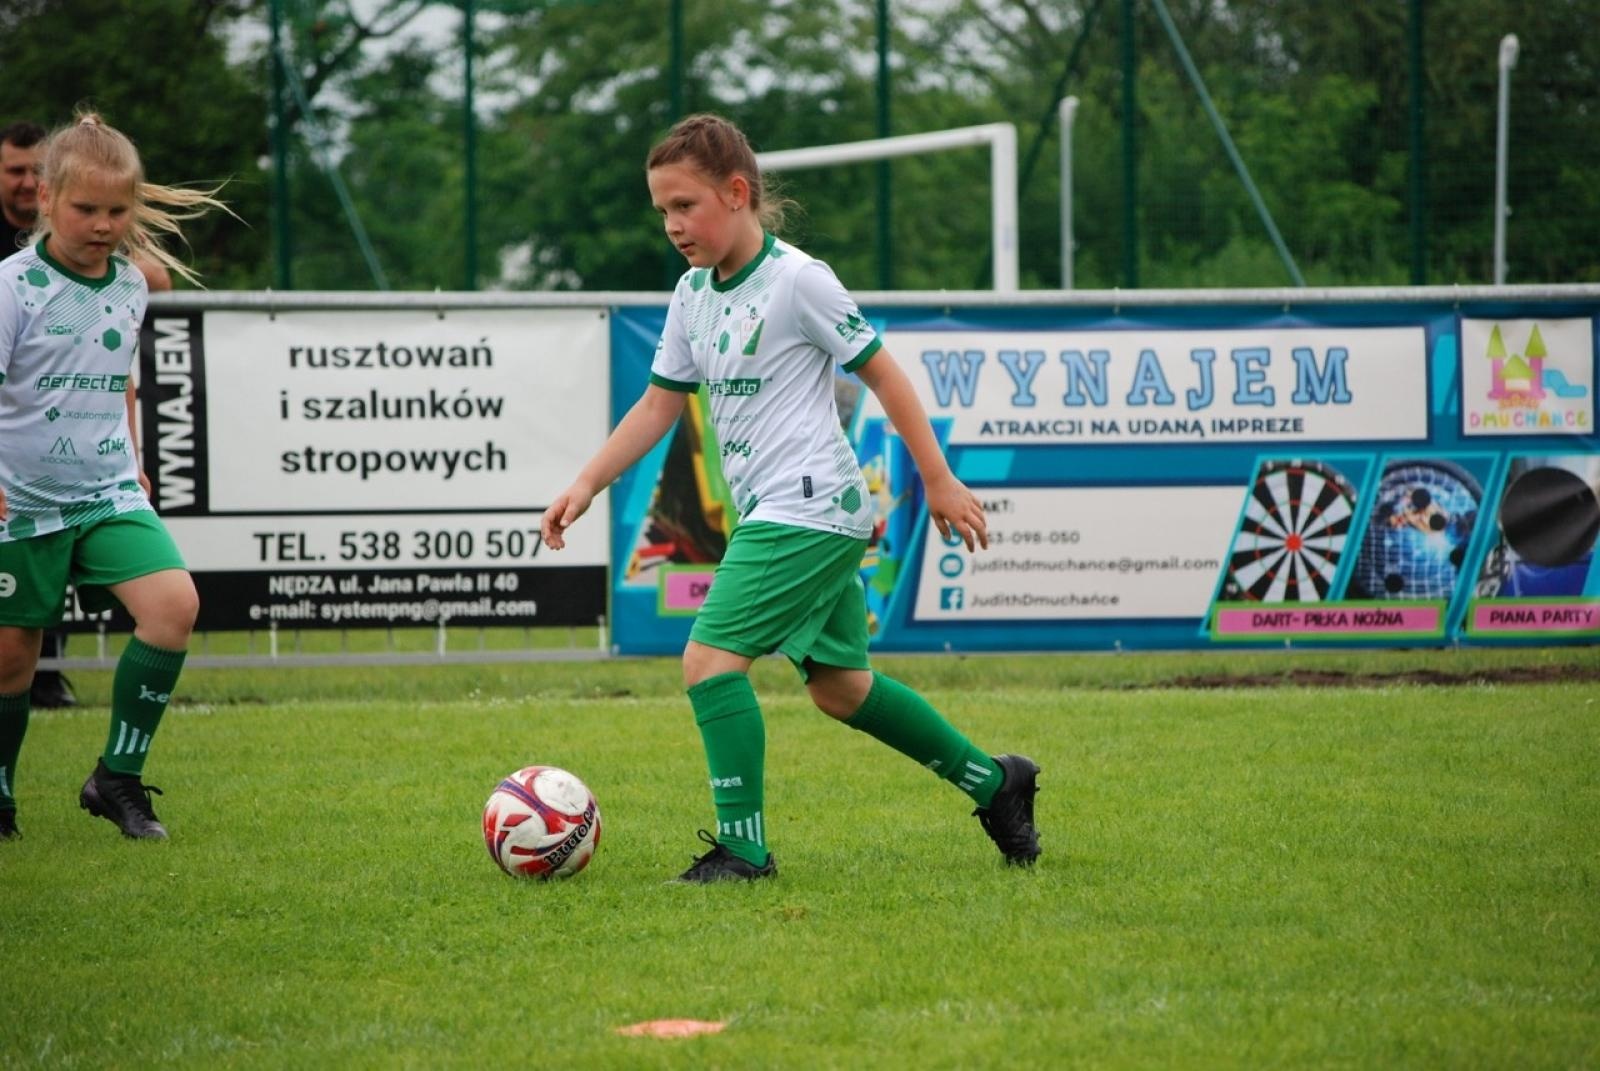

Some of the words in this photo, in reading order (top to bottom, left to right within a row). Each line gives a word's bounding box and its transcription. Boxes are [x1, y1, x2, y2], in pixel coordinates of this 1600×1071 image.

[289, 337, 493, 368] rusztowań
[921, 348, 1353, 411] WYNAJEM
[154, 318, 196, 510] WYNAJEM
[280, 389, 289, 419] i
[303, 387, 504, 419] szalunków
[979, 420, 1083, 436] ATRAKCJI
[1091, 420, 1121, 435] NA
[1128, 419, 1206, 437] UDANĄ
[1212, 418, 1305, 433] IMPREZE
[281, 441, 507, 480] stropowych
[253, 533, 326, 561] TEL.
[339, 532, 400, 560] 538
[413, 531, 473, 560] 300
[486, 530, 545, 558] 507
[269, 576, 336, 598] NĘDZA
[339, 575, 363, 593] ul.
[368, 575, 412, 593] Jana
[494, 573, 519, 591] 40
[250, 601, 317, 619] e-mail:
[321, 598, 537, 621] systempng@gmail.com
[1490, 610, 1537, 624] PIANA
[1542, 609, 1593, 623] PARTY
